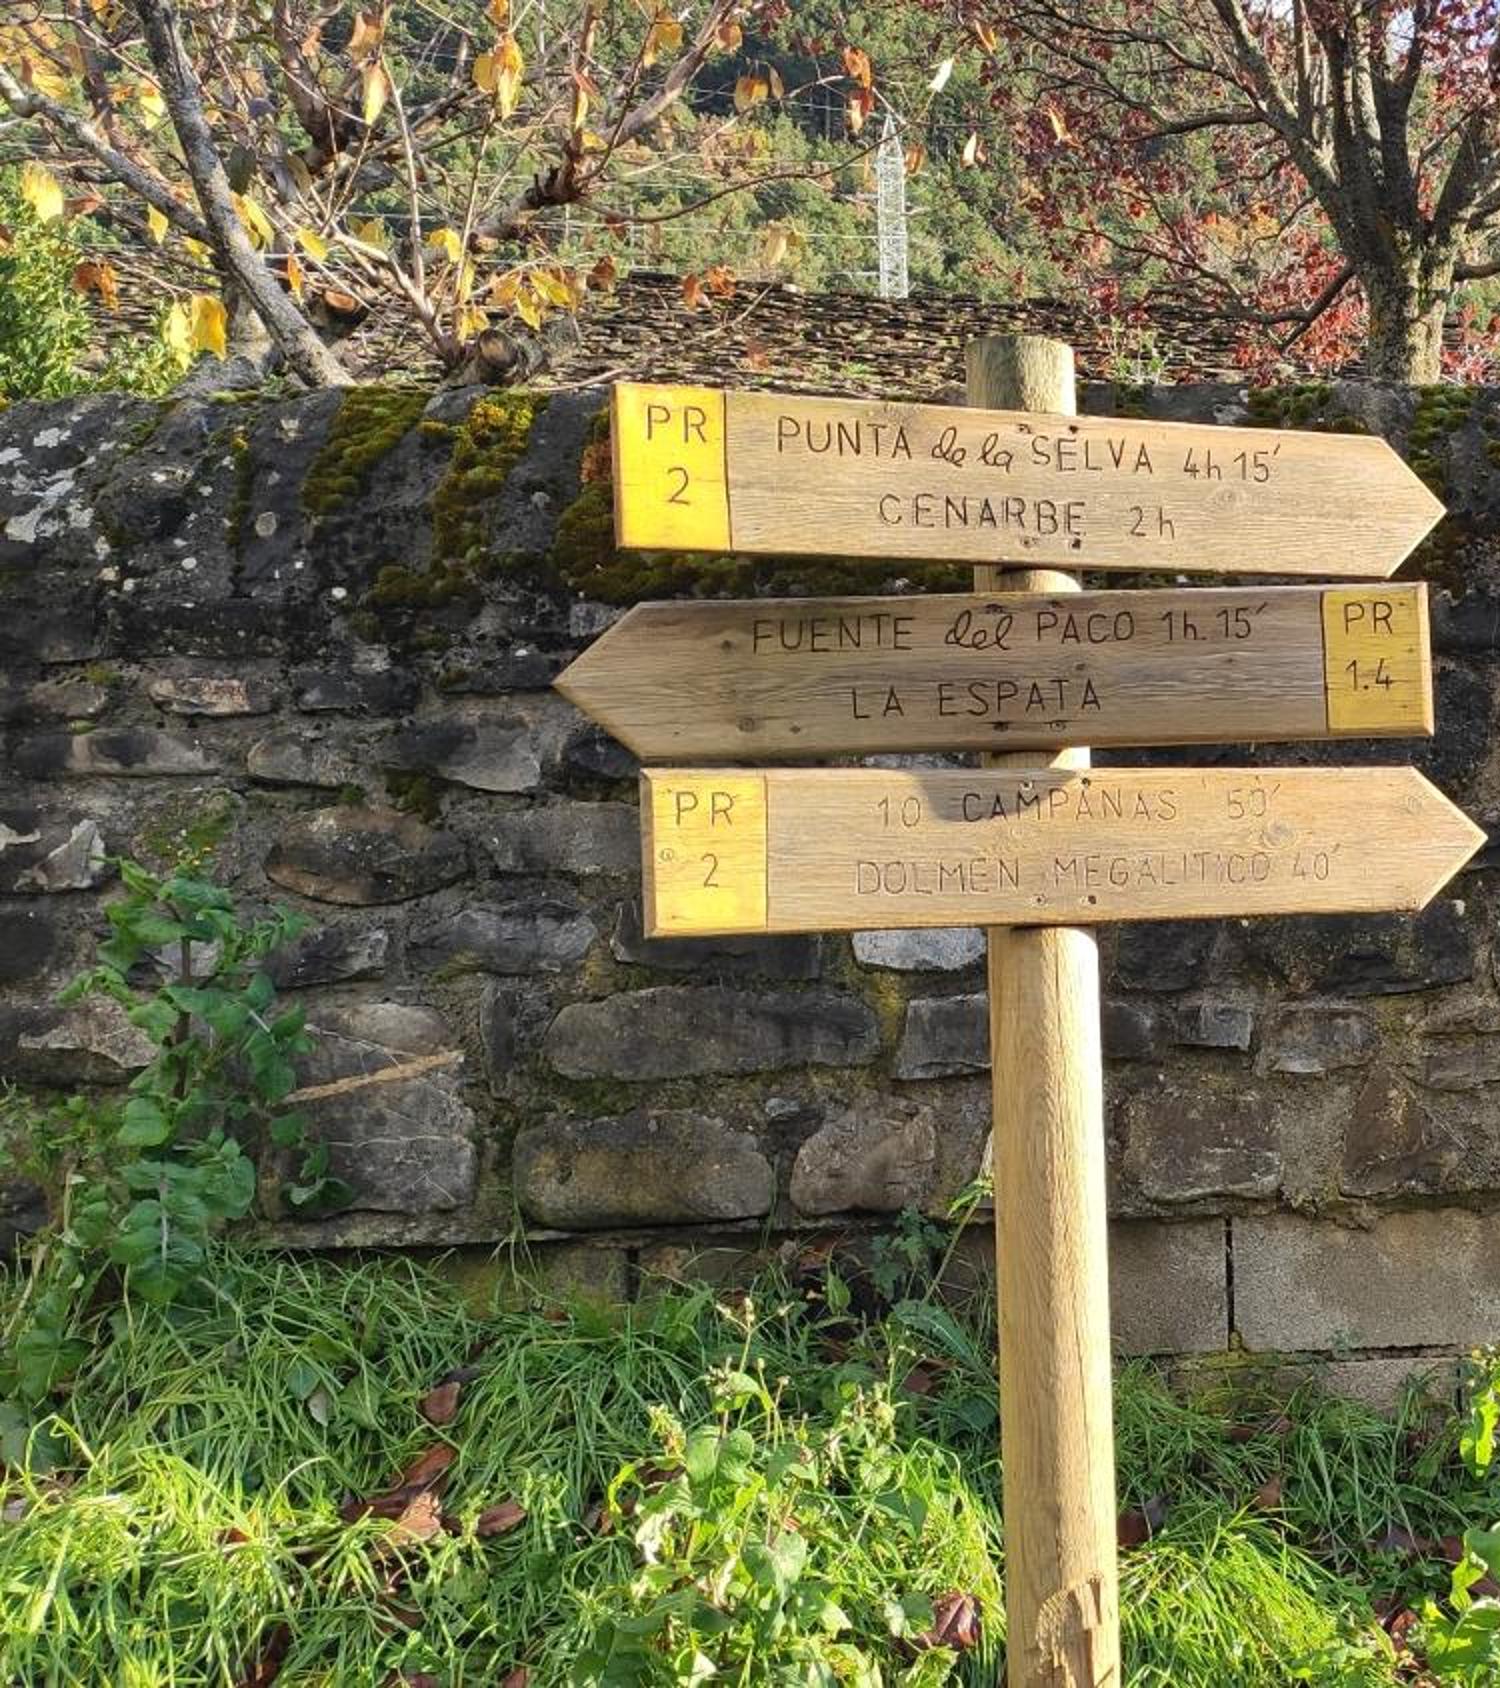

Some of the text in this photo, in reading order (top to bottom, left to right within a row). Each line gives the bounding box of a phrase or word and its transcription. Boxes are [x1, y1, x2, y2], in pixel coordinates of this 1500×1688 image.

[645, 405, 708, 443] PR
[777, 416, 912, 459] PUNTA
[931, 426, 966, 468] de
[976, 434, 1013, 473] la
[1031, 435, 1154, 474] SELVA
[1183, 447, 1221, 481] 4h
[666, 467, 691, 505] 2
[879, 493, 1086, 537] CENARBE
[753, 613, 915, 653] FUENTE
[945, 609, 1013, 650] del
[1037, 611, 1135, 643] PACO
[1343, 602, 1394, 635] PR
[1345, 658, 1393, 691] 1.4
[852, 678, 1101, 719] LA ESPATA
[675, 791, 735, 826] PR
[878, 796, 921, 827] 10
[962, 787, 1178, 822] CAMPANAS
[701, 853, 719, 888] 2
[856, 858, 1020, 895] DOLMEN
[1054, 852, 1269, 887] MEGALITICO
